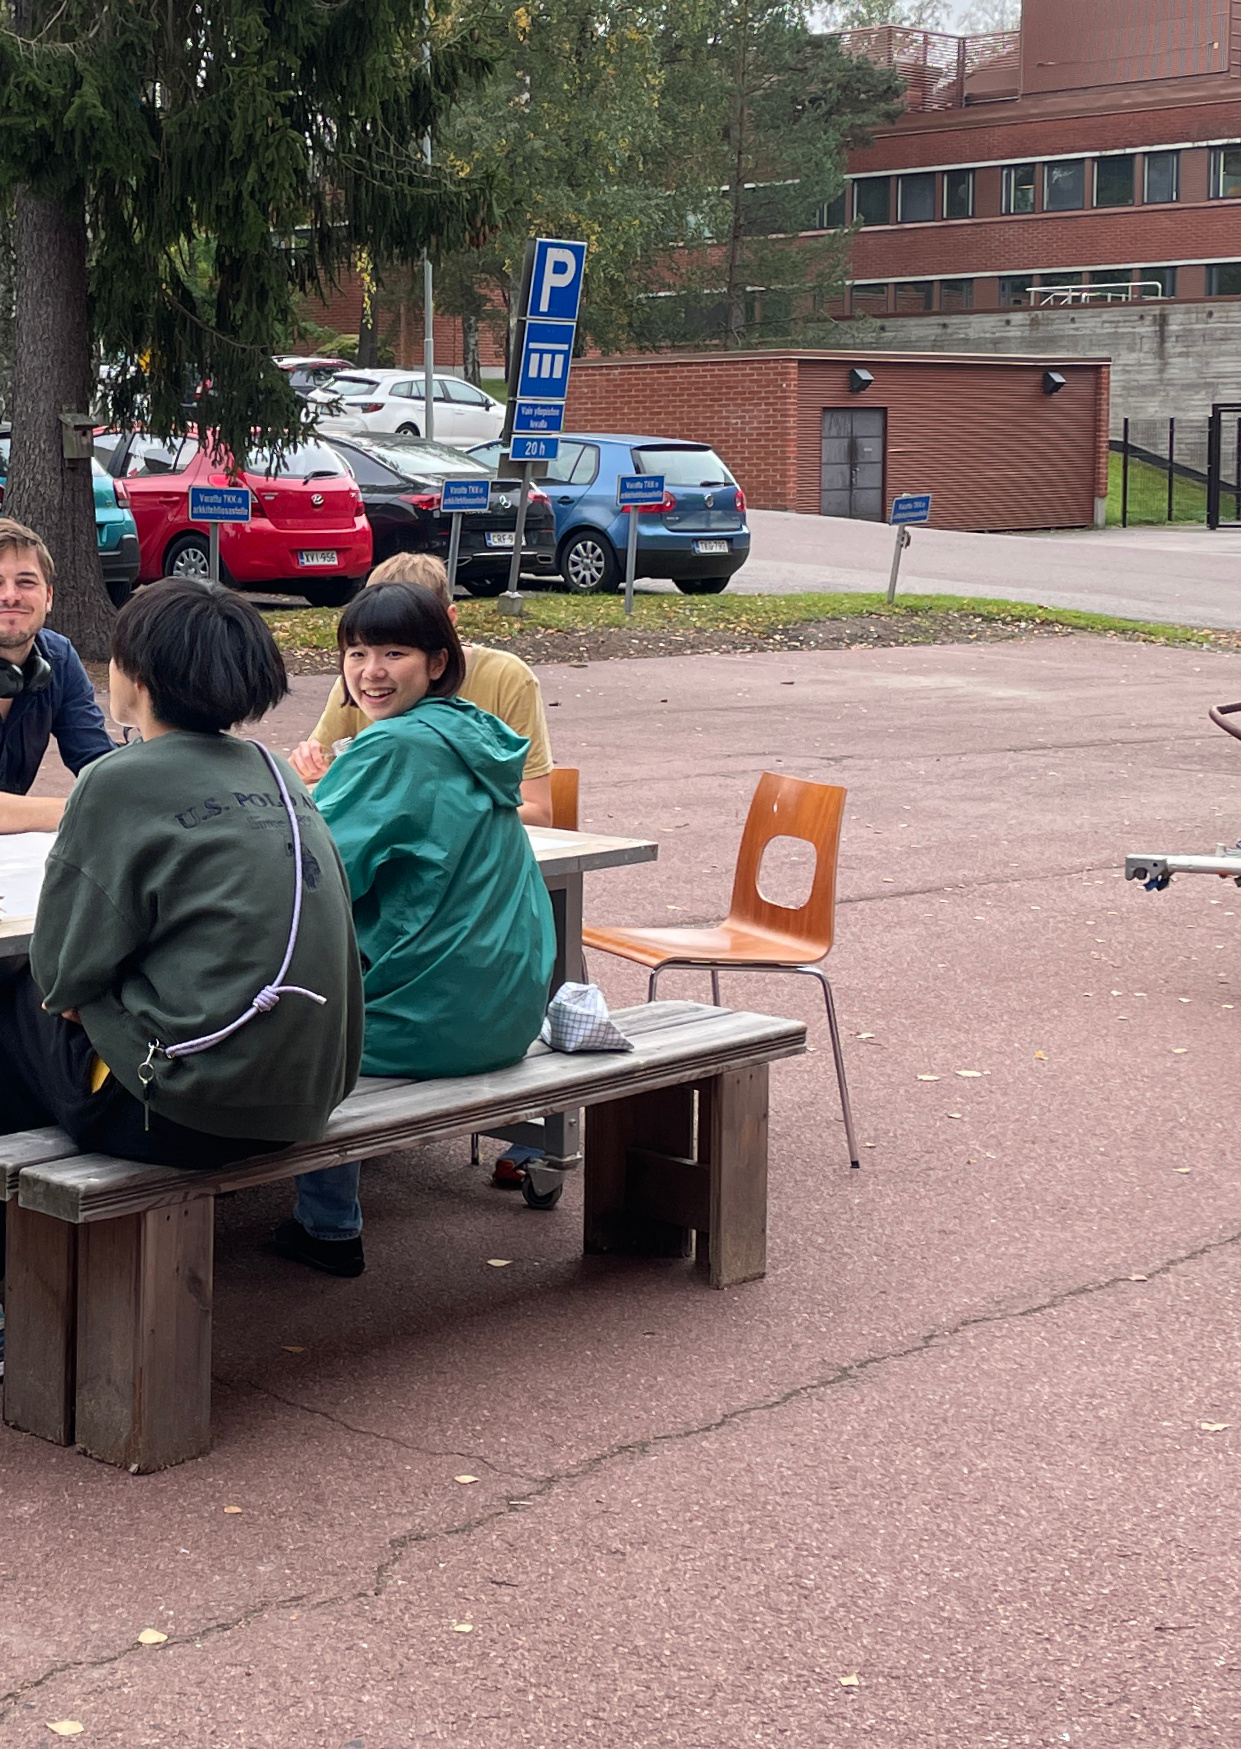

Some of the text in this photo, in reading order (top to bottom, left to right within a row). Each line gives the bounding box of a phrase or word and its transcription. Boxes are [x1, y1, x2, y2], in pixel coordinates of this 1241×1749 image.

[539, 247, 577, 313] P
[525, 441, 546, 456] 20 h
